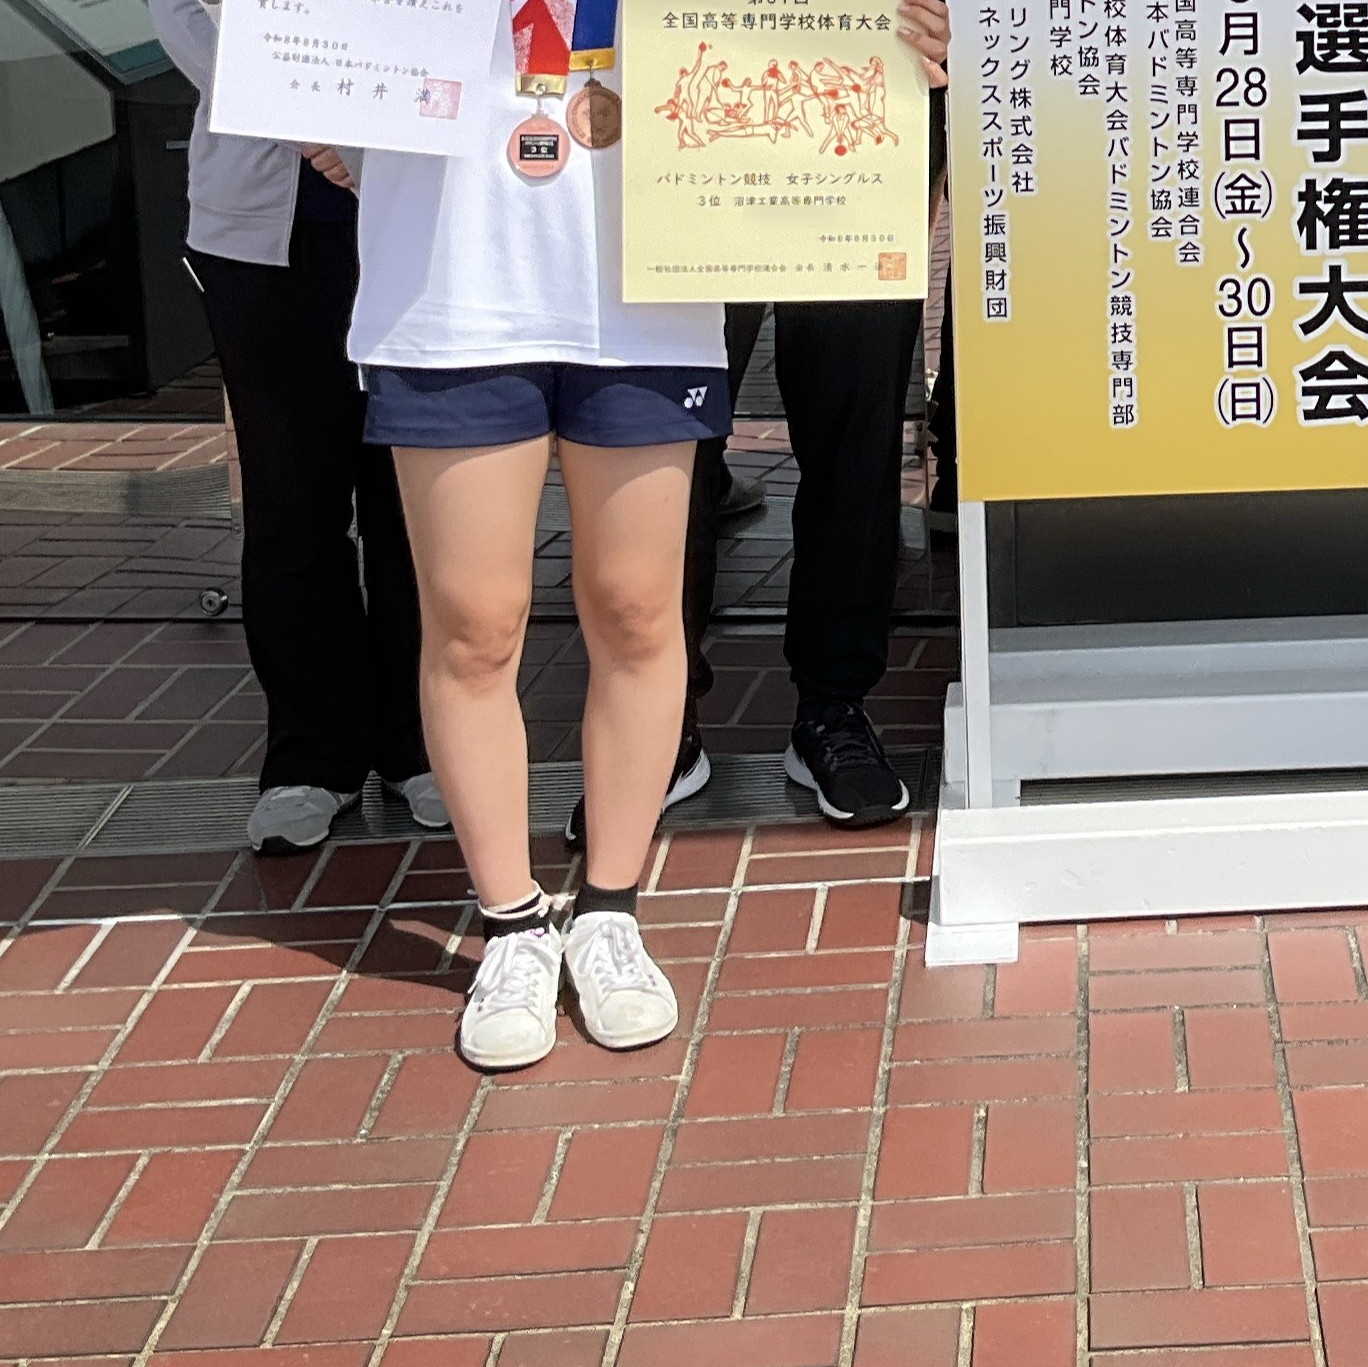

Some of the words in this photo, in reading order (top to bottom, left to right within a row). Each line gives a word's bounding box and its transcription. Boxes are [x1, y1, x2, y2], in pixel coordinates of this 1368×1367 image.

[663, 11, 892, 31] 全国高等専門学校体育大会
